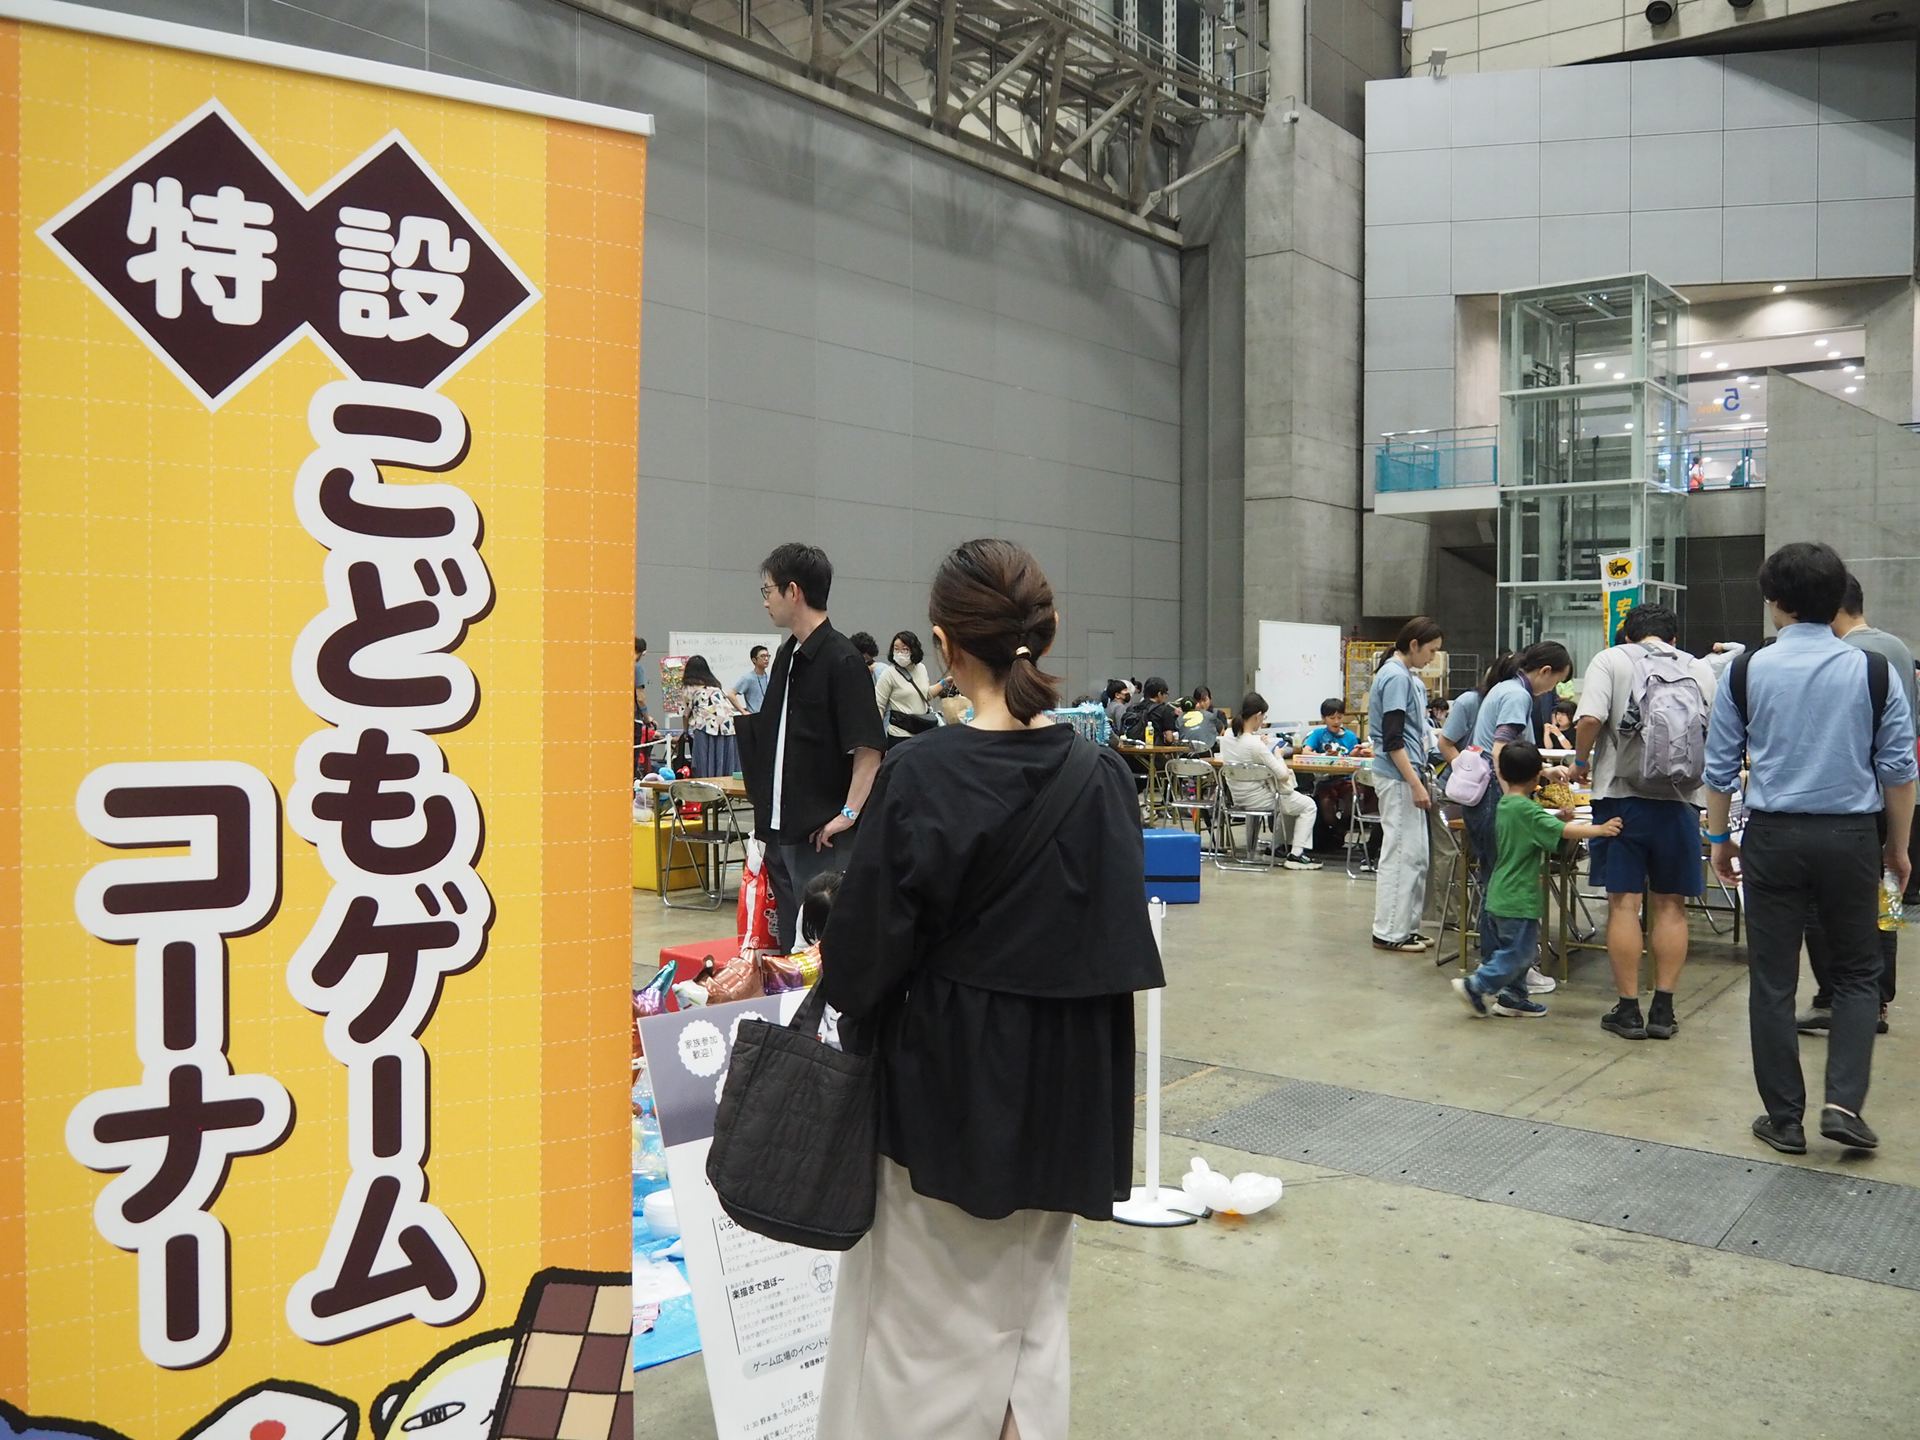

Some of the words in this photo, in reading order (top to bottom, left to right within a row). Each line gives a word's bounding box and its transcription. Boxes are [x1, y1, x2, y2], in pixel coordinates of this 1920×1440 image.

[126, 176, 471, 348] 特設
[88, 780, 270, 1346] コーナー
[305, 398, 474, 1324] こどもゲーム
